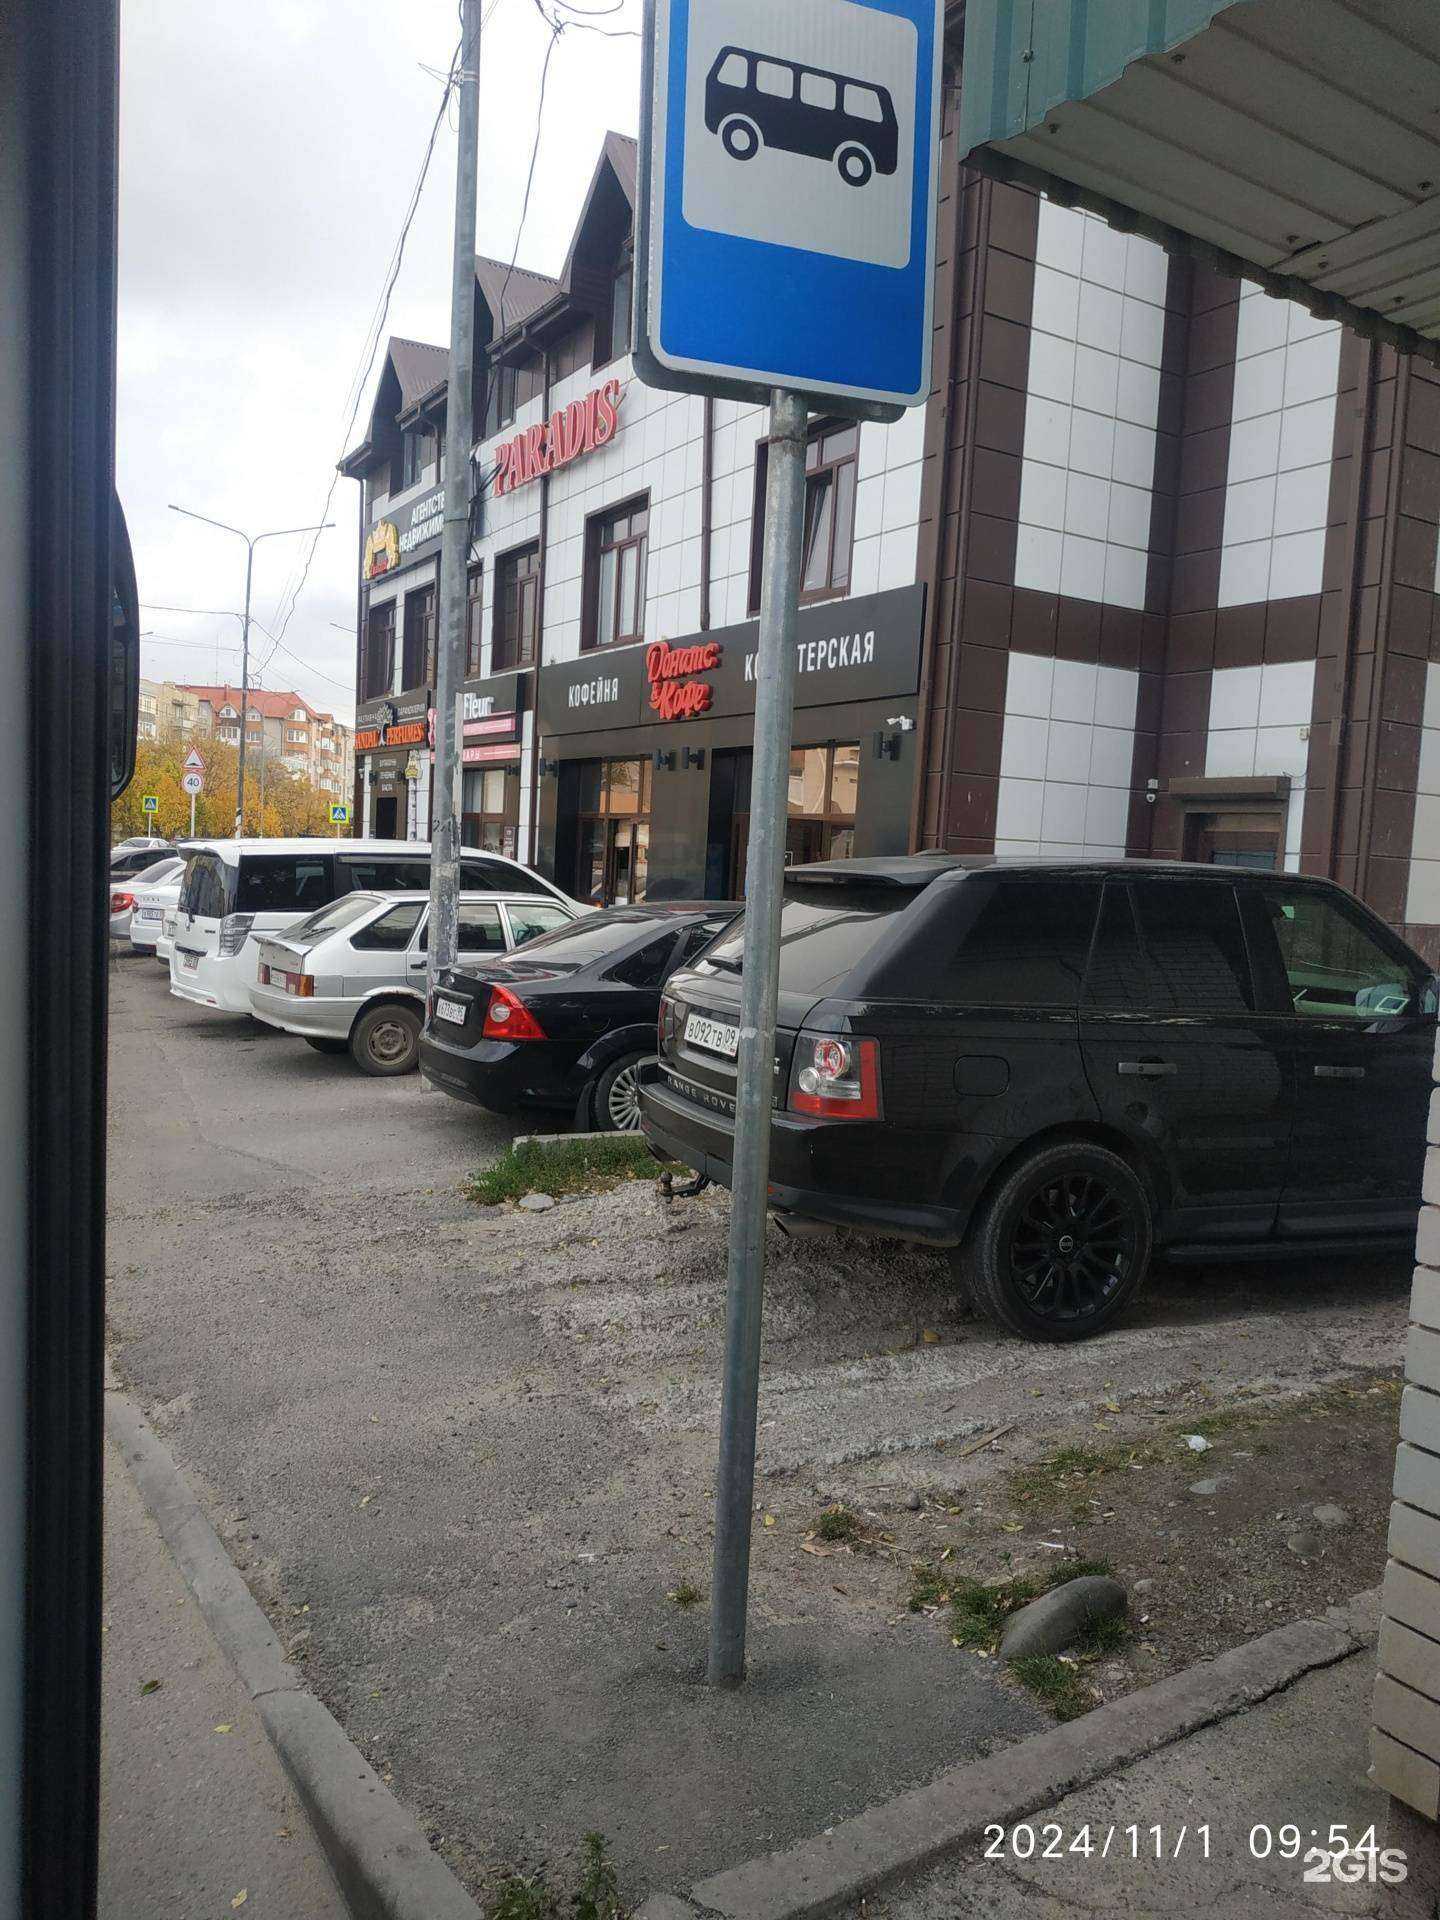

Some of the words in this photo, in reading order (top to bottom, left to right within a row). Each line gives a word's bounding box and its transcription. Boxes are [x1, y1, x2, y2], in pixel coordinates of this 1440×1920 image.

[492, 379, 620, 497] PARADIS
[410, 490, 445, 527] АГЕНТСТ
[568, 676, 619, 708] КОФЕЙНЯ
[187, 777, 200, 787] 40
[667, 1074, 697, 1098] RANGE
[703, 1093, 737, 1113] ROVE
